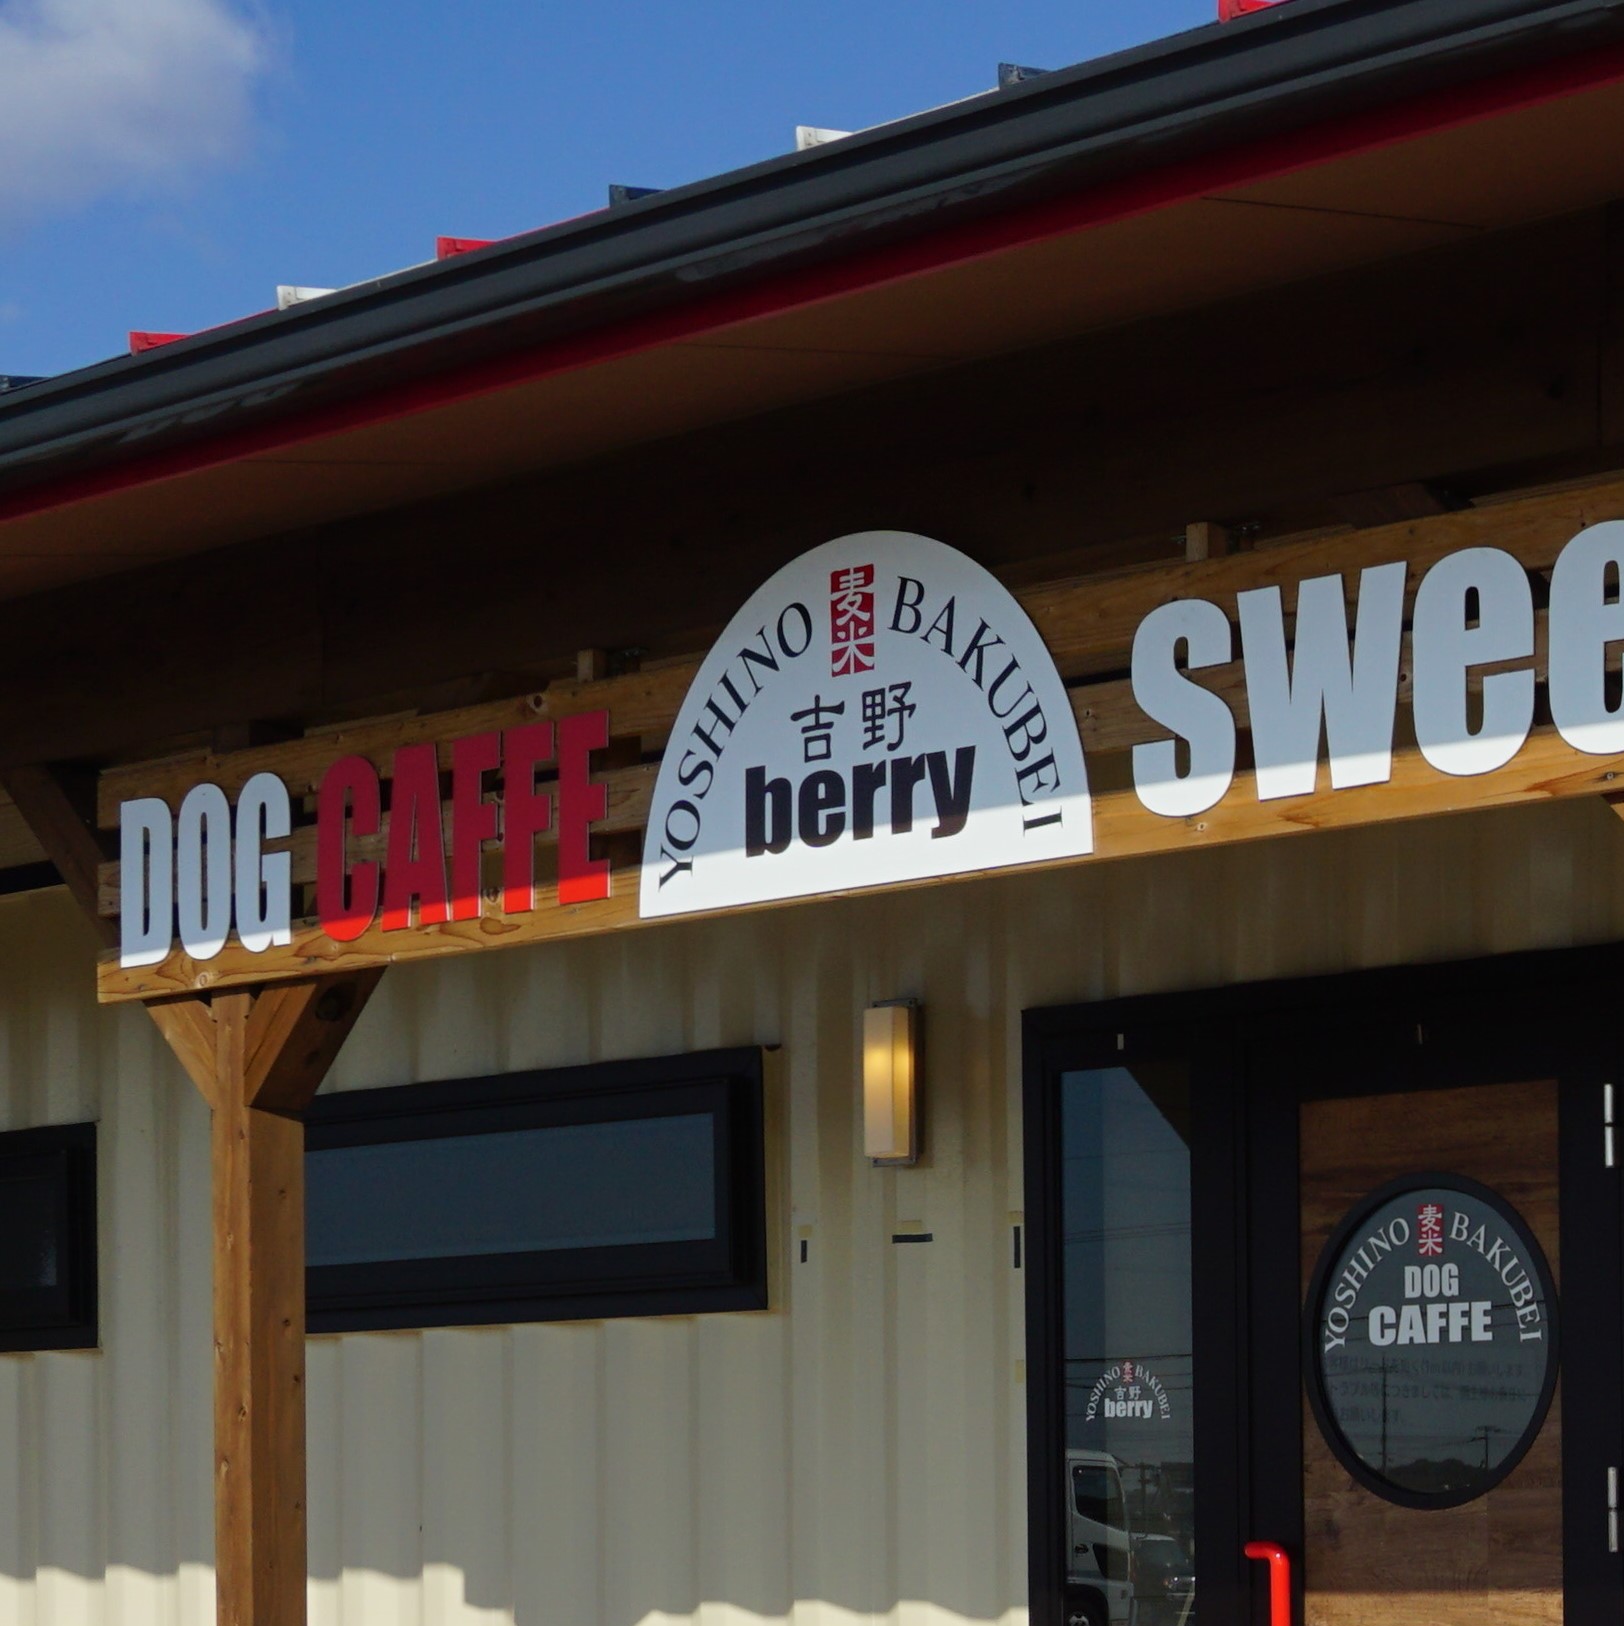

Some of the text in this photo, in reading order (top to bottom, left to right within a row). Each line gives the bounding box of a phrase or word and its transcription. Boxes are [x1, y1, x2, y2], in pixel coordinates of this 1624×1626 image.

[830, 563, 875, 677] 麦米
[658, 601, 813, 891] YOSHINO
[790, 681, 917, 763] 吉野
[888, 574, 1064, 836] BAKUBEI
[120, 710, 610, 968] DOG CAFFE
[745, 746, 976, 857] berry
[1417, 1203, 1444, 1256] 麦米
[1450, 1212, 1542, 1343] BAKUBEI
[1324, 1217, 1410, 1353] YOSHINO
[1368, 1301, 1493, 1346] CAFFE
[1404, 1263, 1459, 1298] DOG
[1086, 1366, 1120, 1421] YOSHINO
[1104, 1398, 1153, 1419] berry
[1135, 1365, 1171, 1419] BAKUBEI
